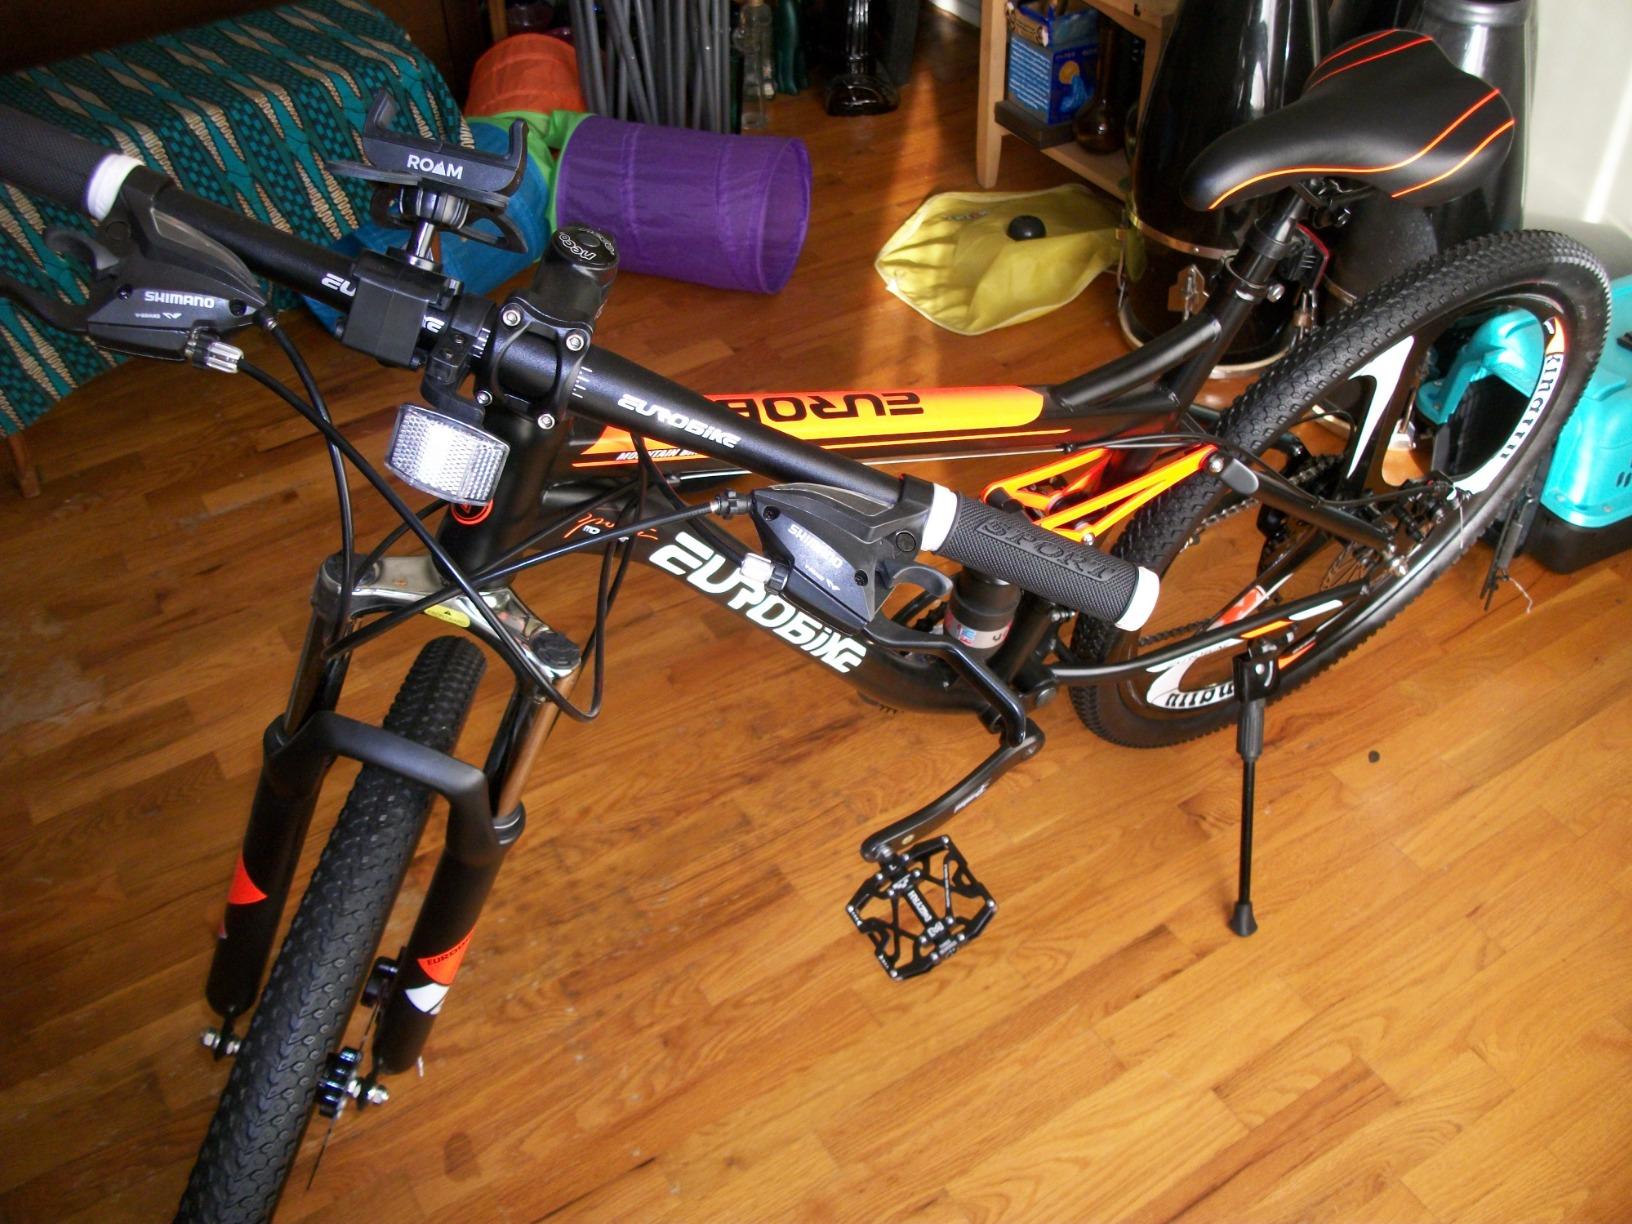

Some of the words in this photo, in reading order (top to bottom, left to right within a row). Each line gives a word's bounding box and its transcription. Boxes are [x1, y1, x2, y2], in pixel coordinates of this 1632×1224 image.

[407, 154, 463, 180] ROAM
[144, 291, 215, 309] SHIMANO
[617, 393, 741, 449] EUROBIKE
[715, 391, 924, 423] EUROB
[983, 520, 1116, 579] SPORT
